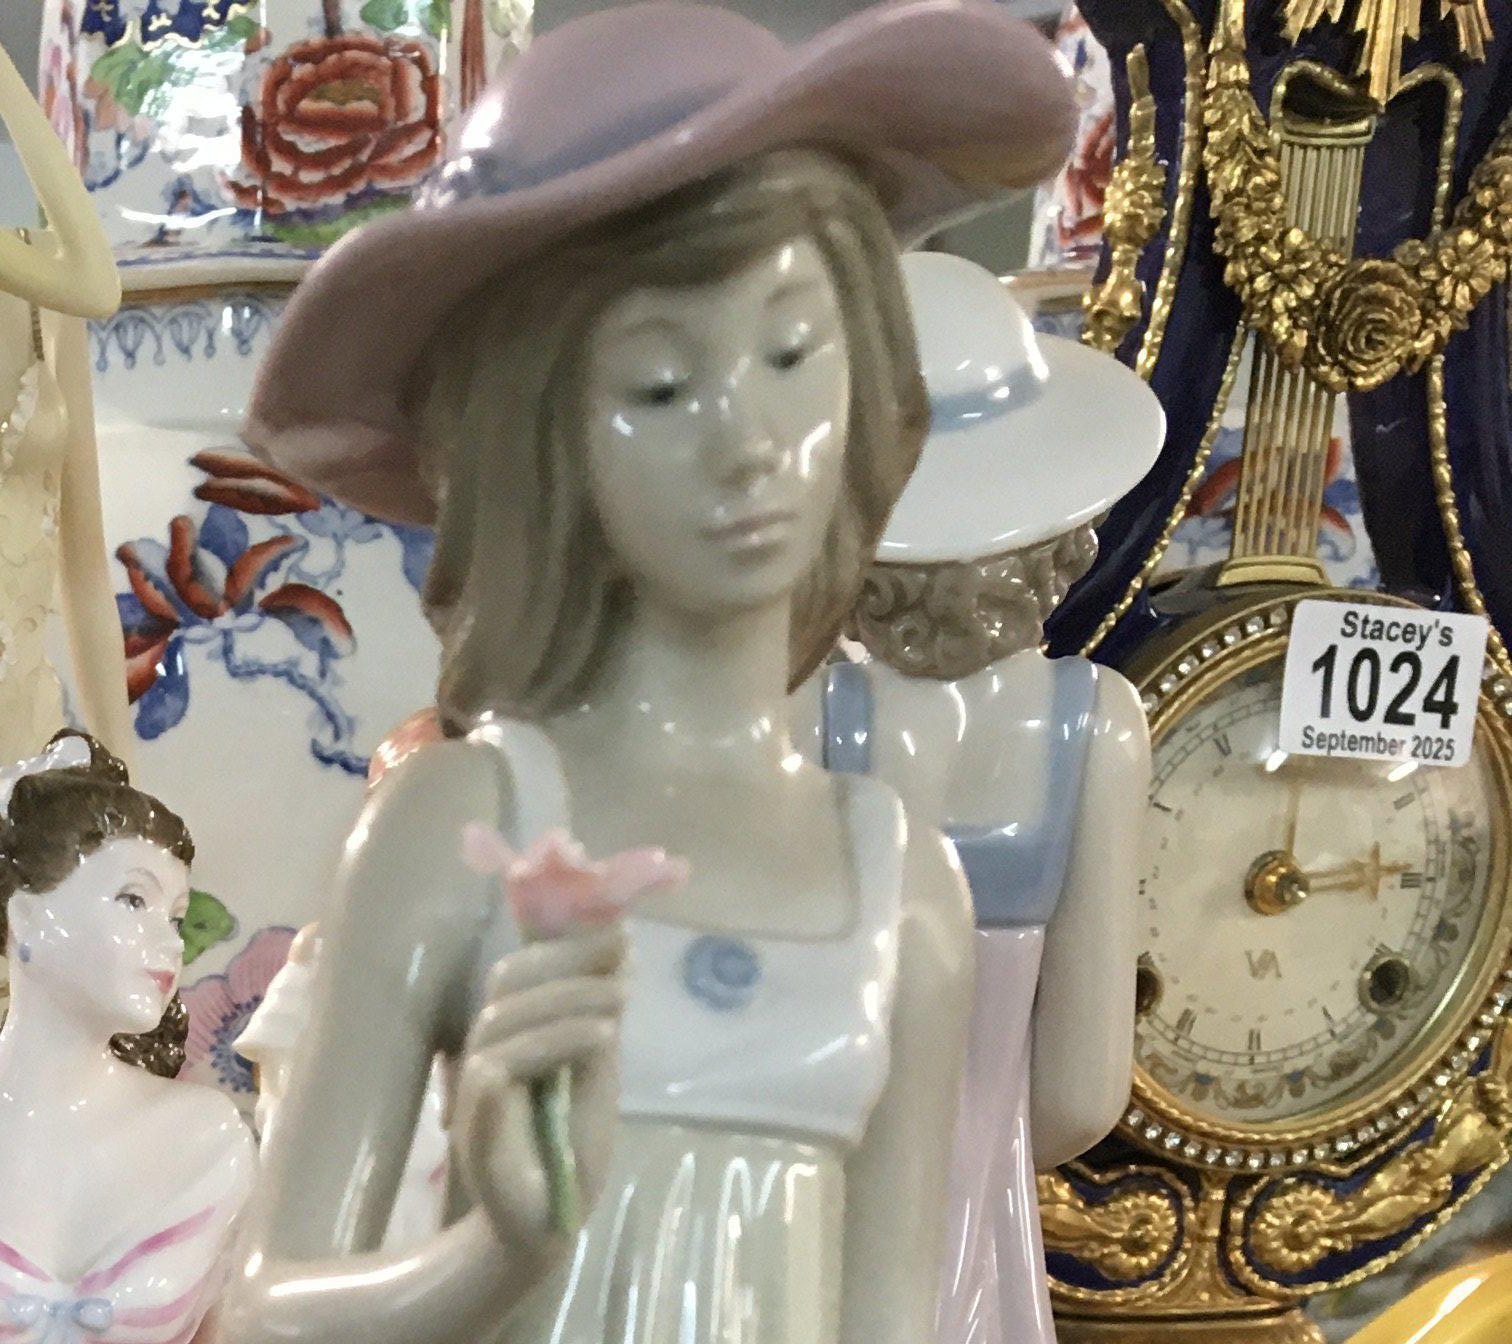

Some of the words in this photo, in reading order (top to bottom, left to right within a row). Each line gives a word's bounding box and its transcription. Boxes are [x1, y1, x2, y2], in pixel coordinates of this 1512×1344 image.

[1340, 610, 1455, 651] Stacey's
[1311, 643, 1460, 730] 1024
[1301, 725, 1406, 756] September
[1411, 735, 1455, 761] 2025
